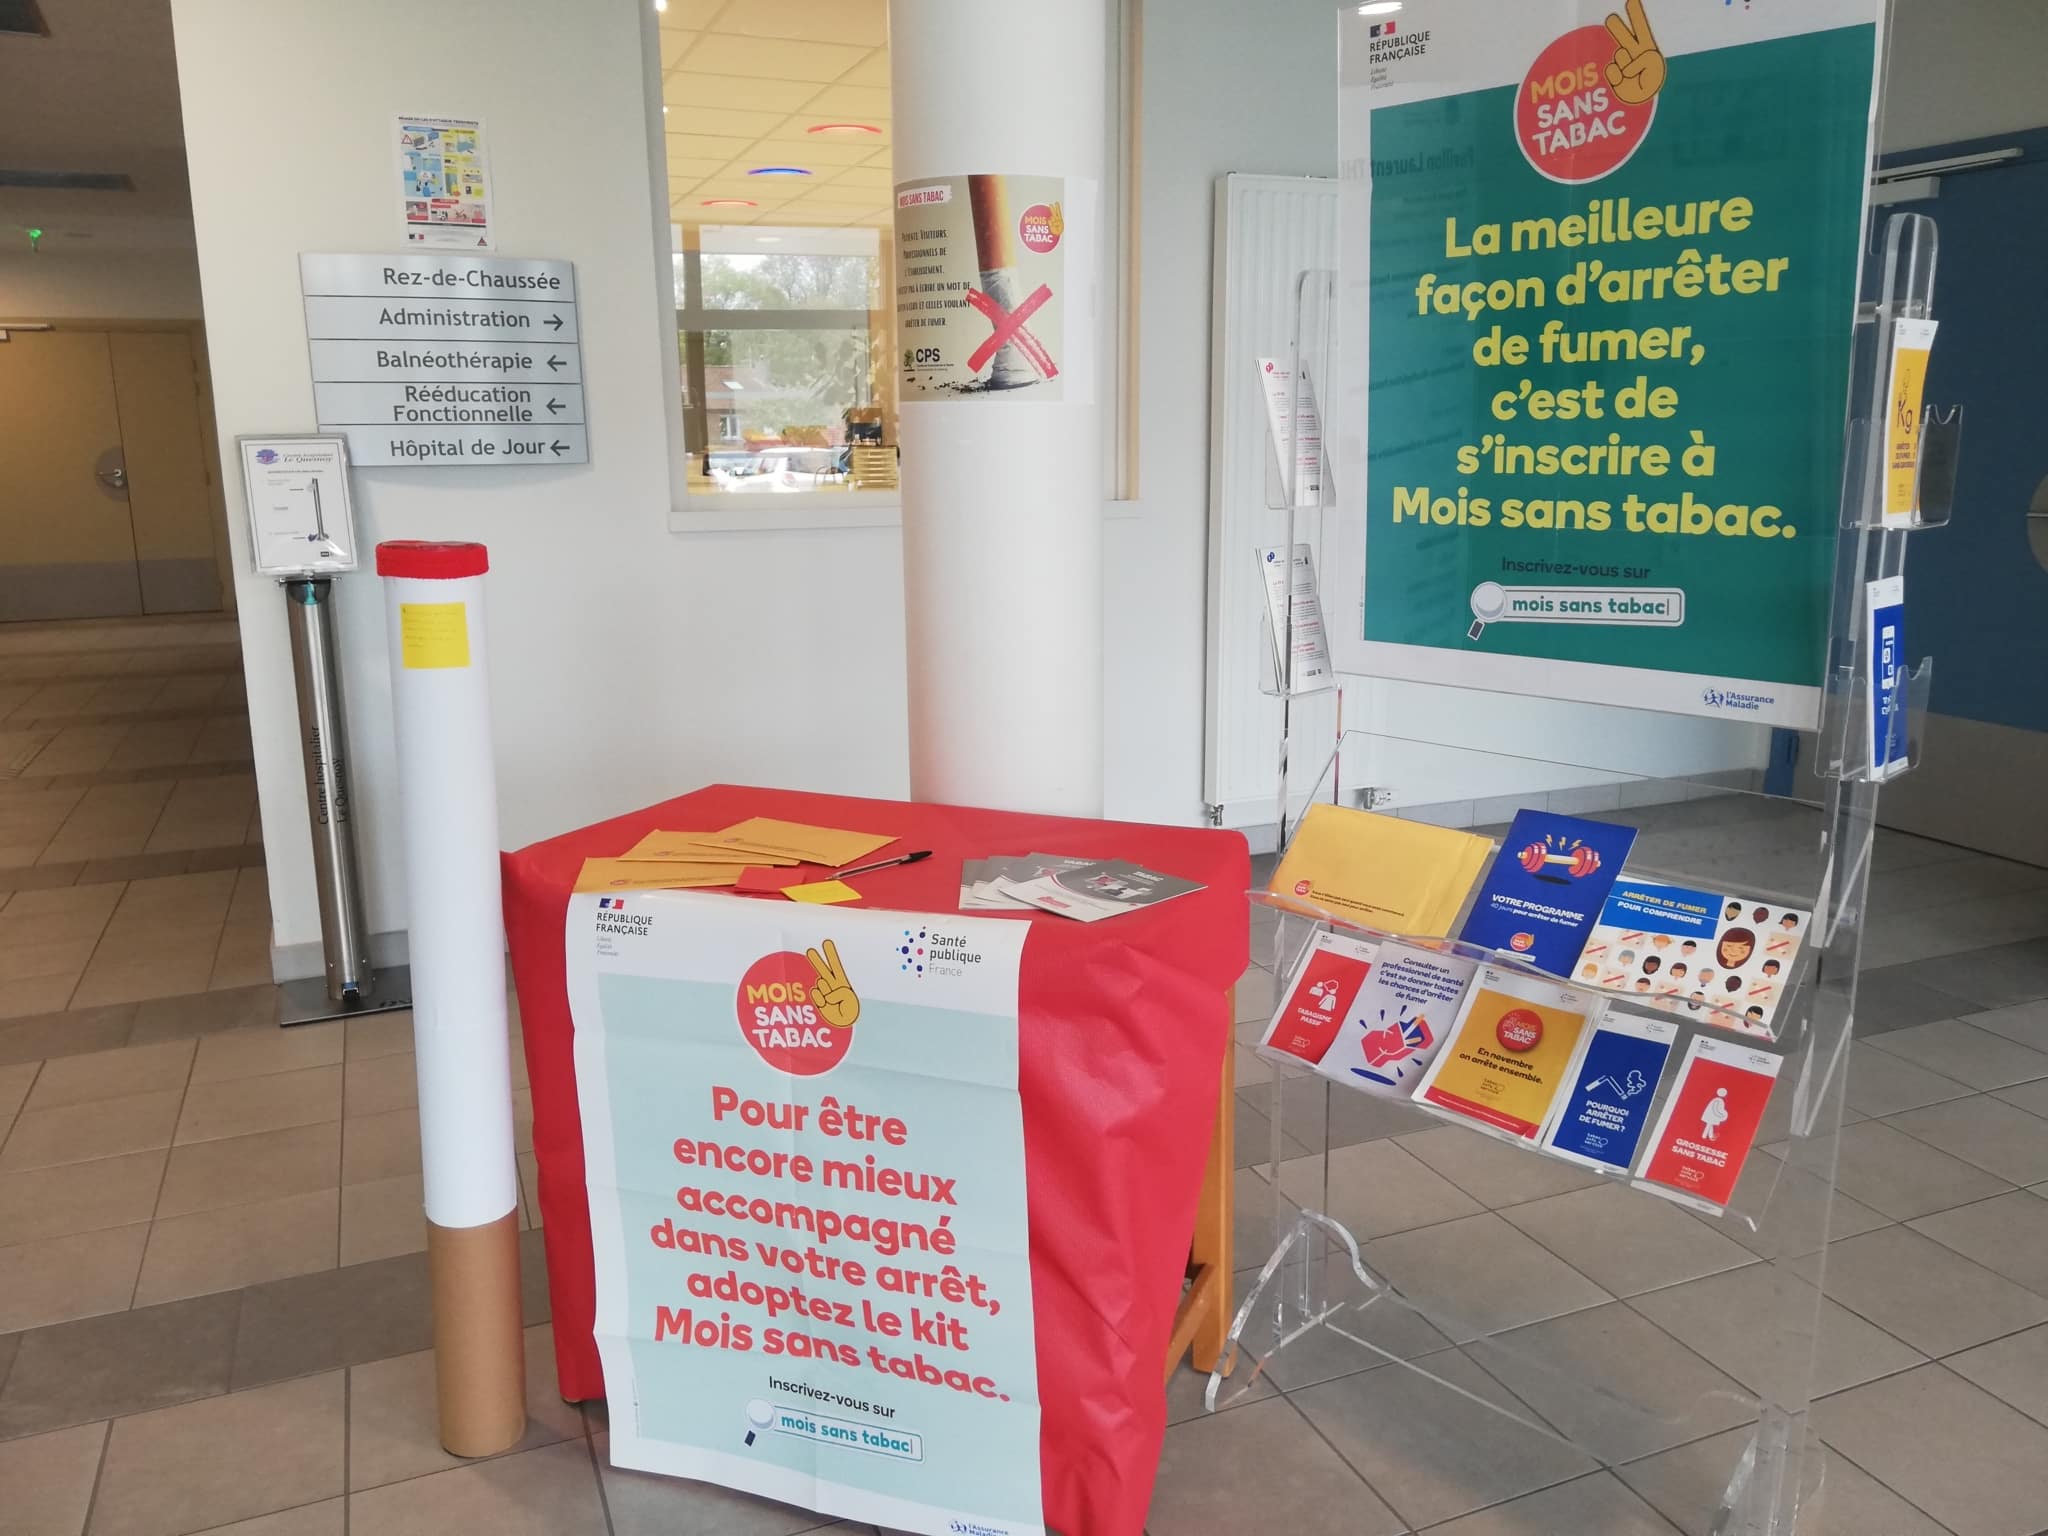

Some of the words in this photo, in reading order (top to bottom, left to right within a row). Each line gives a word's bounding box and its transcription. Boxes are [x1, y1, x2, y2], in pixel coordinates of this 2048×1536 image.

[1370, 30, 1431, 52] RÉPUBLIQUE
[1370, 44, 1426, 64] FRANÇAISE
[1530, 60, 1600, 106] MOIS
[1537, 87, 1610, 129] SANS
[1533, 110, 1627, 156] TABAC
[923, 190, 944, 203] TABAC
[1024, 215, 1047, 225] MOIS
[1026, 224, 1049, 234] SANS
[1446, 217, 1500, 258] La
[1511, 196, 1753, 253] meilleure
[1024, 233, 1054, 243] TABAC
[383, 268, 561, 290] Rez-de-Chaussée
[947, 281, 961, 291] MOT
[1415, 272, 1545, 320] façon
[379, 308, 531, 328] Administration
[1473, 325, 1529, 366] de
[1539, 320, 1706, 366] fumer,
[377, 350, 533, 373] Balnéothérapie
[916, 348, 940, 363] CPS
[405, 385, 532, 403] Rééducation
[1491, 379, 1604, 421] c'est
[1614, 376, 1678, 419] de
[393, 405, 533, 423] Fonctionnelle
[390, 439, 464, 459] Hôpital
[471, 440, 496, 456] de
[502, 439, 546, 456] Jour
[1457, 432, 1671, 476] s'inscrire
[1681, 429, 1716, 477] à
[1393, 486, 1492, 526] Mois
[1500, 498, 1612, 532] sans
[1622, 492, 1797, 539] tabac.
[1502, 557, 1619, 578] Inscrivez-vous
[1623, 566, 1651, 579] sur
[1512, 596, 1554, 613] mois
[1559, 599, 1603, 614] sans
[1608, 598, 1666, 616] tabac
[1726, 700, 1760, 710] Maladie
[310, 725, 327, 785] hospitalier
[317, 787, 328, 825] Centre
[1492, 893, 1523, 908] VOTRE
[1523, 901, 1585, 921] PROGRAMME
[1513, 908, 1528, 917] pour
[1559, 918, 1578, 927] fumer
[1617, 901, 1641, 912] POUR
[1642, 906, 1703, 925] COMPRENDRE
[1662, 899, 1676, 908] DE
[1676, 902, 1707, 914] FUMER
[596, 923, 648, 936] FRANÇAISE
[597, 911, 653, 926] RÉPUBLIQUE
[931, 933, 967, 947] Santé
[930, 949, 981, 965] publique
[1403, 957, 1439, 972] Consulter
[929, 963, 962, 976] France
[1382, 961, 1431, 978] professionnel
[1442, 977, 1464, 987] santé
[746, 982, 807, 1004] MOIS
[1378, 977, 1389, 985] les
[1390, 980, 1420, 994] chances
[1408, 976, 1434, 988] donner
[1434, 983, 1459, 995] toutes
[1405, 993, 1428, 1004] fumer
[754, 1005, 817, 1026] SANS
[752, 1028, 833, 1049] TABAC
[1503, 1030, 1531, 1045] TABAC
[1513, 1026, 1536, 1039] SANS
[1459, 1052, 1471, 1061] on
[1471, 1055, 1498, 1070] arrête
[1499, 1064, 1543, 1085] ensemble.
[1477, 1047, 1491, 1058] En
[1490, 1052, 1534, 1070] novembre
[712, 1085, 809, 1131] Pour
[819, 1095, 907, 1146] être
[1586, 1100, 1629, 1117] POURQUOI
[1579, 1114, 1591, 1123] DE
[1591, 1118, 1620, 1131] FUMER
[1672, 1145, 1695, 1158] SANS
[1696, 1153, 1726, 1168] TABAC
[1676, 1138, 1729, 1160] GROSSESSE
[673, 1136, 813, 1183] encore
[823, 1155, 957, 1205] mieux
[676, 1186, 957, 1256] accompagné
[650, 1218, 749, 1262] dans
[756, 1244, 866, 1286] votre
[875, 1265, 1000, 1316] arrêt,
[687, 1272, 855, 1322] adoptez
[862, 1300, 901, 1337] le
[911, 1309, 969, 1351] kit
[655, 1305, 753, 1351] Mois
[763, 1327, 861, 1367] sans
[867, 1345, 1011, 1402] tabac.
[769, 1375, 871, 1416] Inscrivez-vous
[873, 1402, 896, 1419] sur
[781, 1413, 816, 1434] mois
[821, 1424, 858, 1442] sans
[862, 1429, 910, 1453] tabac
